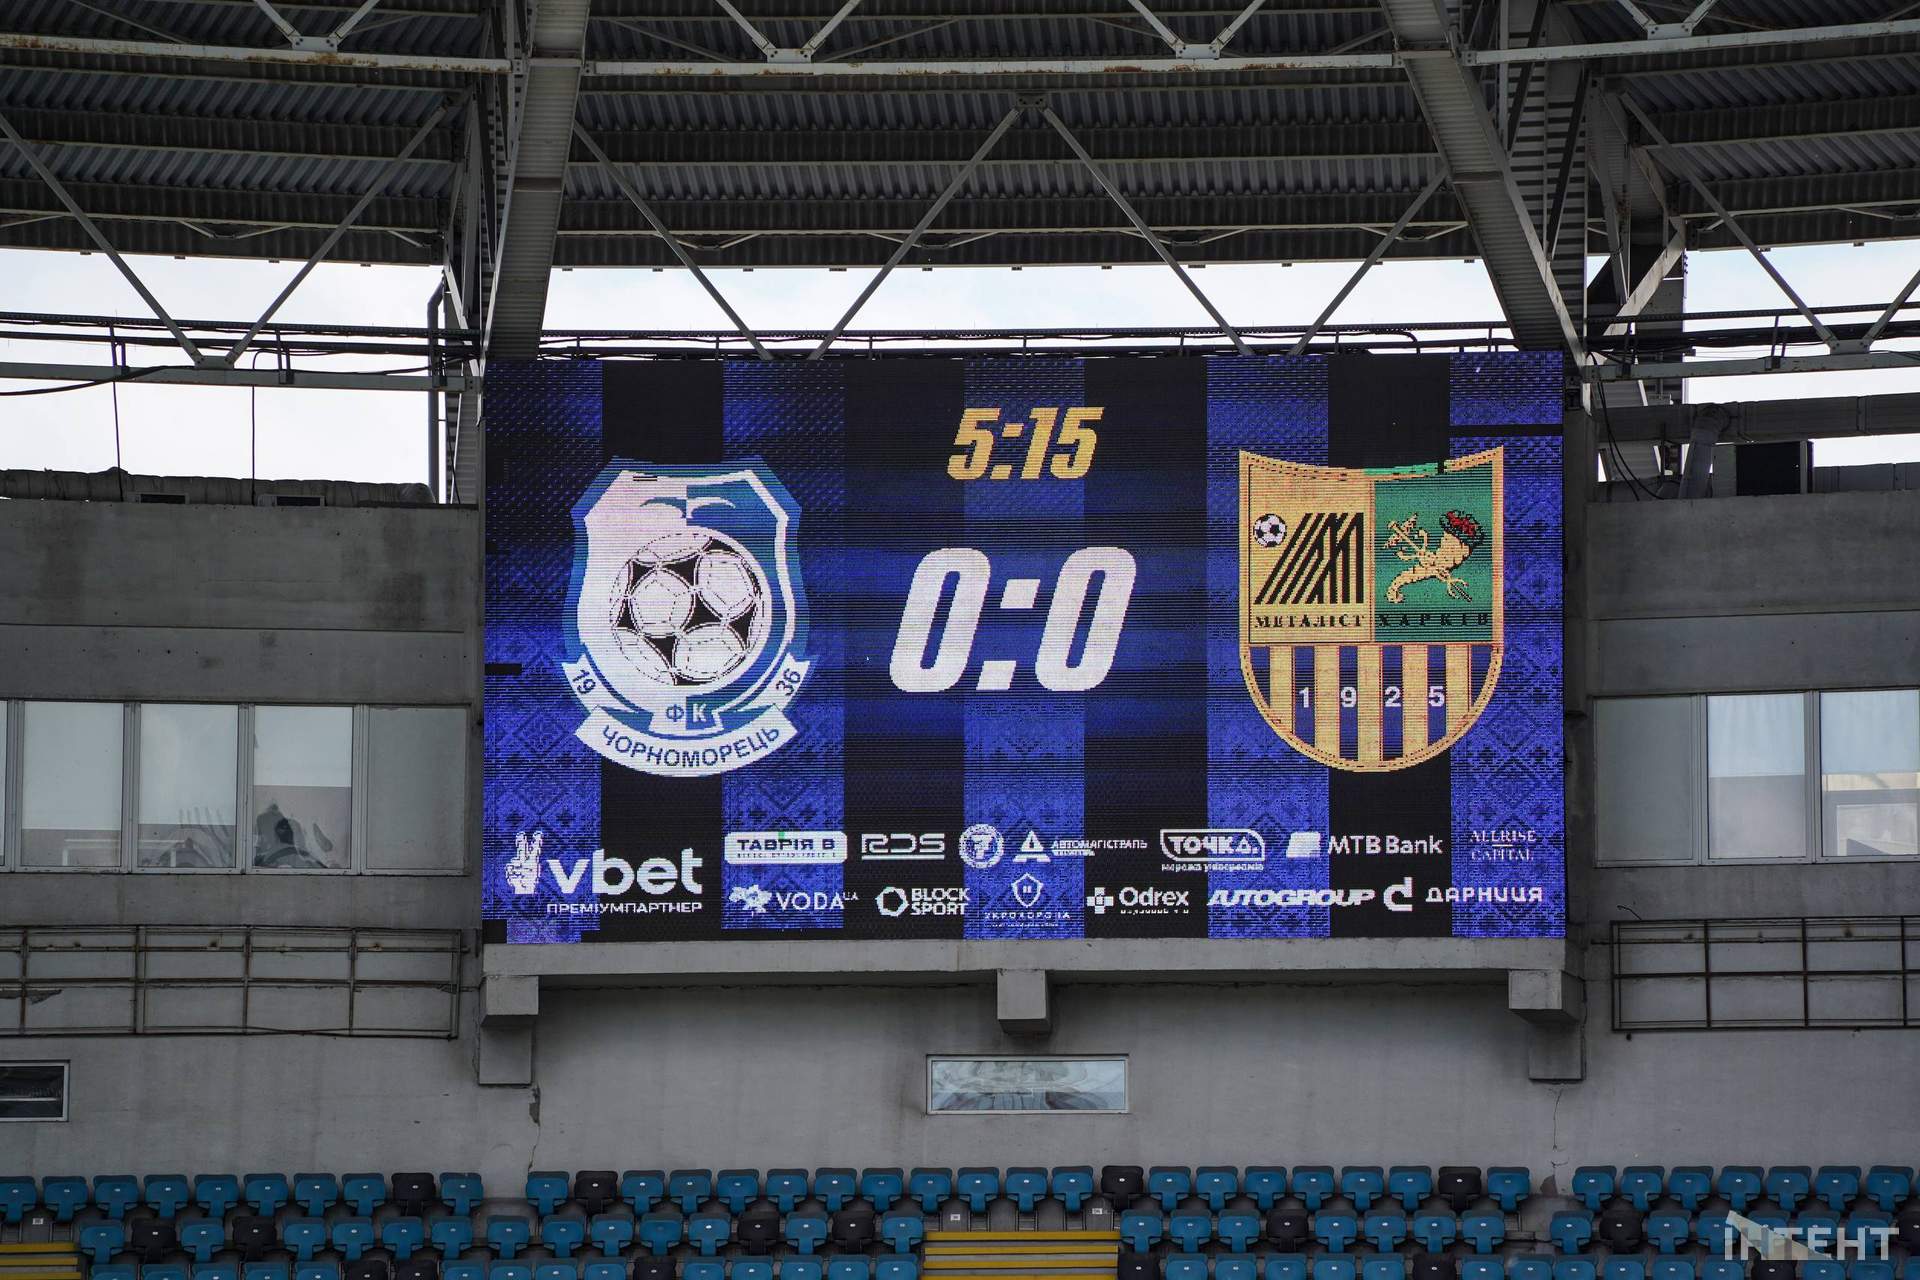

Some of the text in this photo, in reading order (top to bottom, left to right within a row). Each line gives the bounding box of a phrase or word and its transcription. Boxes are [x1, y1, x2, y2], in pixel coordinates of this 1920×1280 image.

[947, 407, 1104, 479] 5:15
[889, 547, 1136, 692] 0:0
[1254, 613, 1365, 628] МЕТАЛІСТ
[1378, 613, 1489, 627] ХАРКІВ
[571, 669, 597, 695] 19
[776, 668, 803, 696] 36
[665, 704, 707, 723] ФК
[601, 723, 780, 767] ЧОРНОМОРЕЦЬ
[736, 838, 814, 850] ТАВРІЯ
[861, 833, 945, 854] RDS
[547, 848, 703, 895] vbet
[911, 888, 971, 901] BLOCK
[1119, 886, 1189, 906] Odrex
[1207, 889, 1376, 907] AUTOGROUP
[1425, 887, 1543, 903] ДАРНИЦЯ
[910, 902, 969, 915] SPORT
